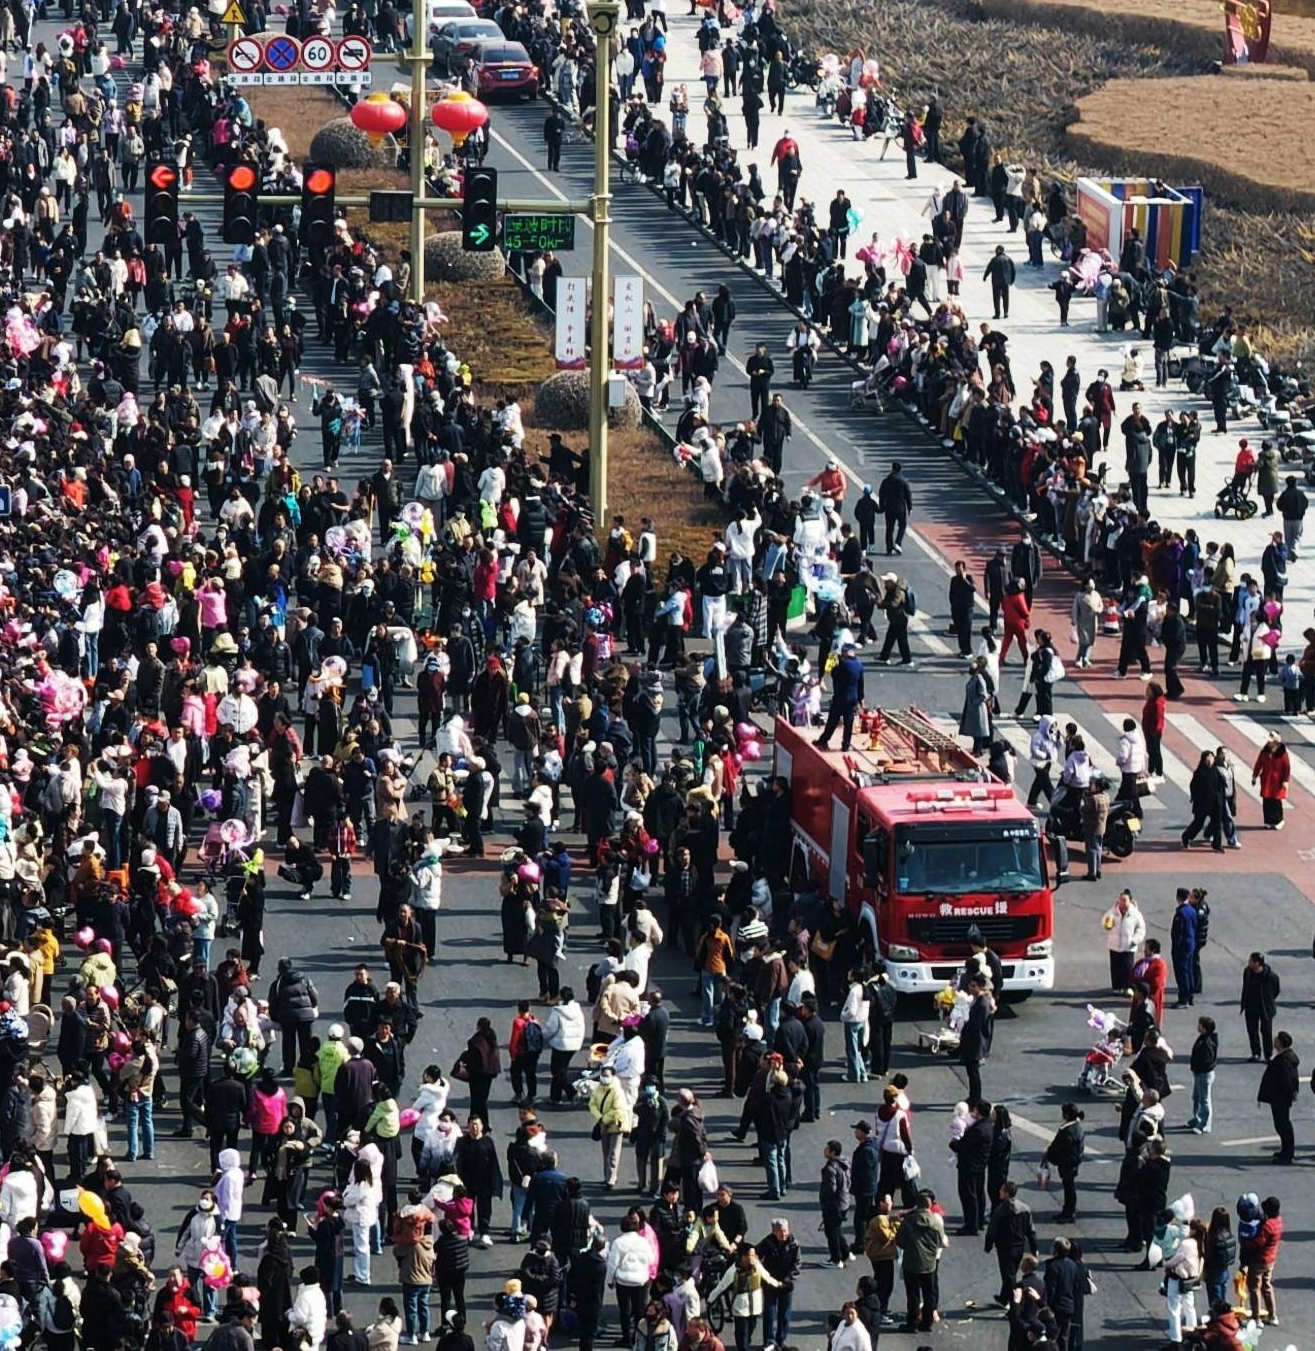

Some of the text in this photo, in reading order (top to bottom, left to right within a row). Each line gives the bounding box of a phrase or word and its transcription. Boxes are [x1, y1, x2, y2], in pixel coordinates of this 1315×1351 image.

[308, 47, 327, 61] 60
[939, 901, 1008, 917] 救 RESCUE 援
